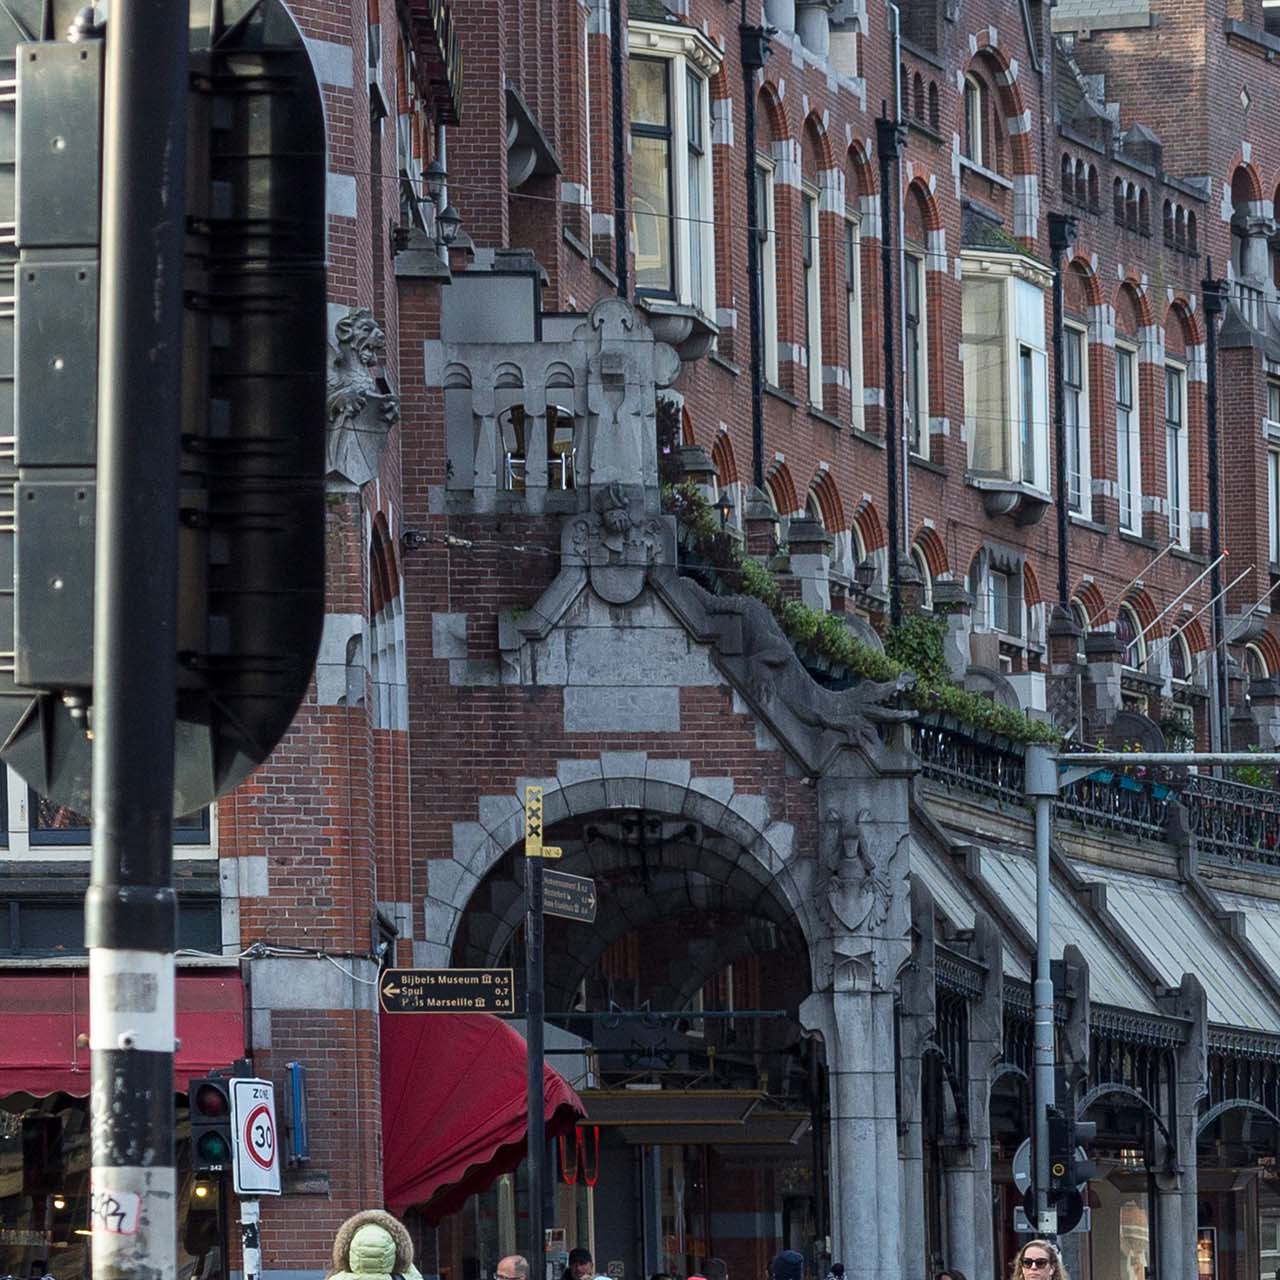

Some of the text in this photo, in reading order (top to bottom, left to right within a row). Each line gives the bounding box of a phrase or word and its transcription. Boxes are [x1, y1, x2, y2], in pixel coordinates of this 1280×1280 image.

[401, 975, 435, 986] Bijbels
[438, 975, 479, 984] Museum
[401, 986, 424, 996] Spui
[427, 997, 473, 1006] Marseille
[254, 1125, 272, 1149] 30
